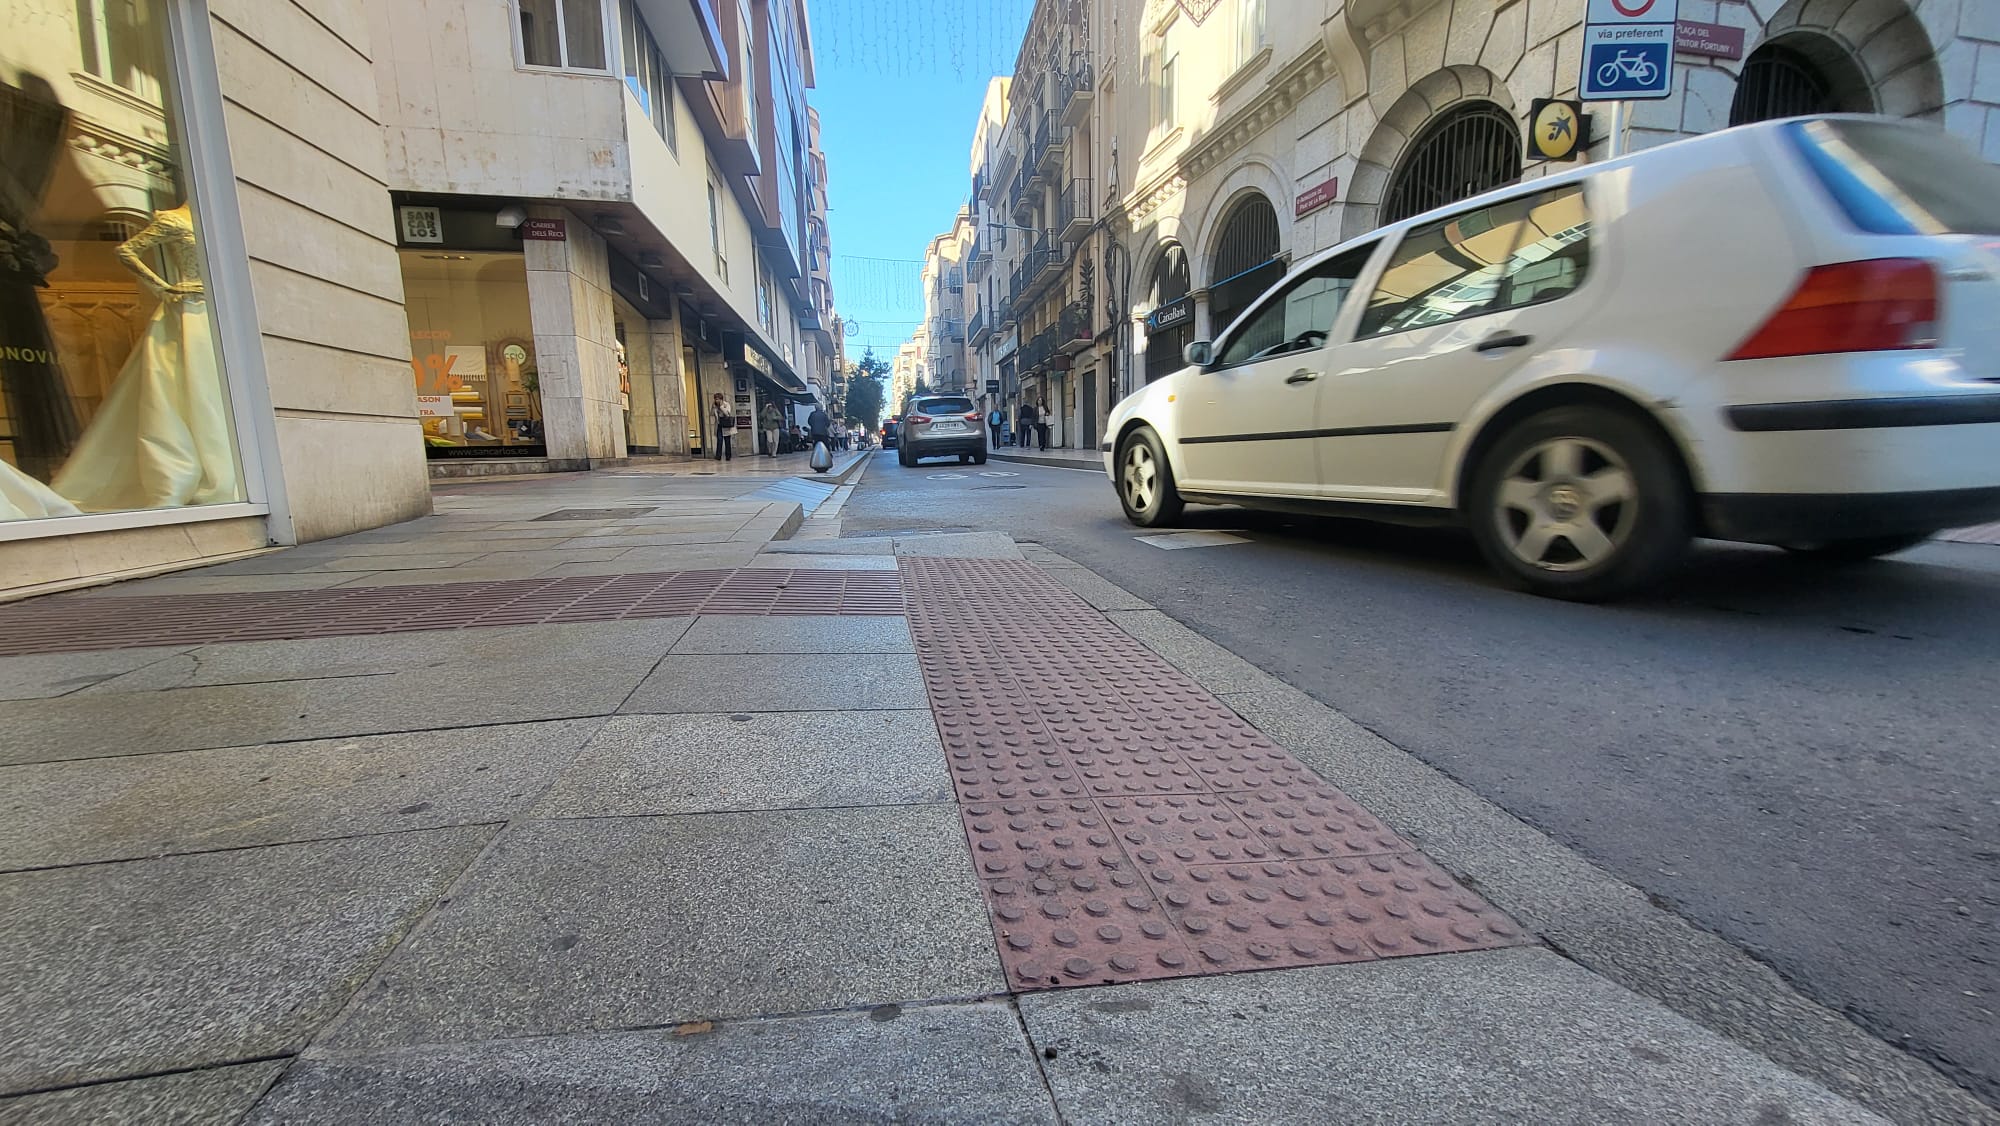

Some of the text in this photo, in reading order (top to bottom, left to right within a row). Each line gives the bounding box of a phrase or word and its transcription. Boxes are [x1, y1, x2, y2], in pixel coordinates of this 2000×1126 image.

[1598, 29, 1664, 40] via preferent
[407, 211, 435, 220] SAN
[407, 220, 436, 229] CAR
[531, 221, 556, 229] CARRER
[410, 229, 438, 238] LOS
[1158, 303, 1187, 325] CaixaBank
[448, 447, 529, 457] www.sancarlos.es
